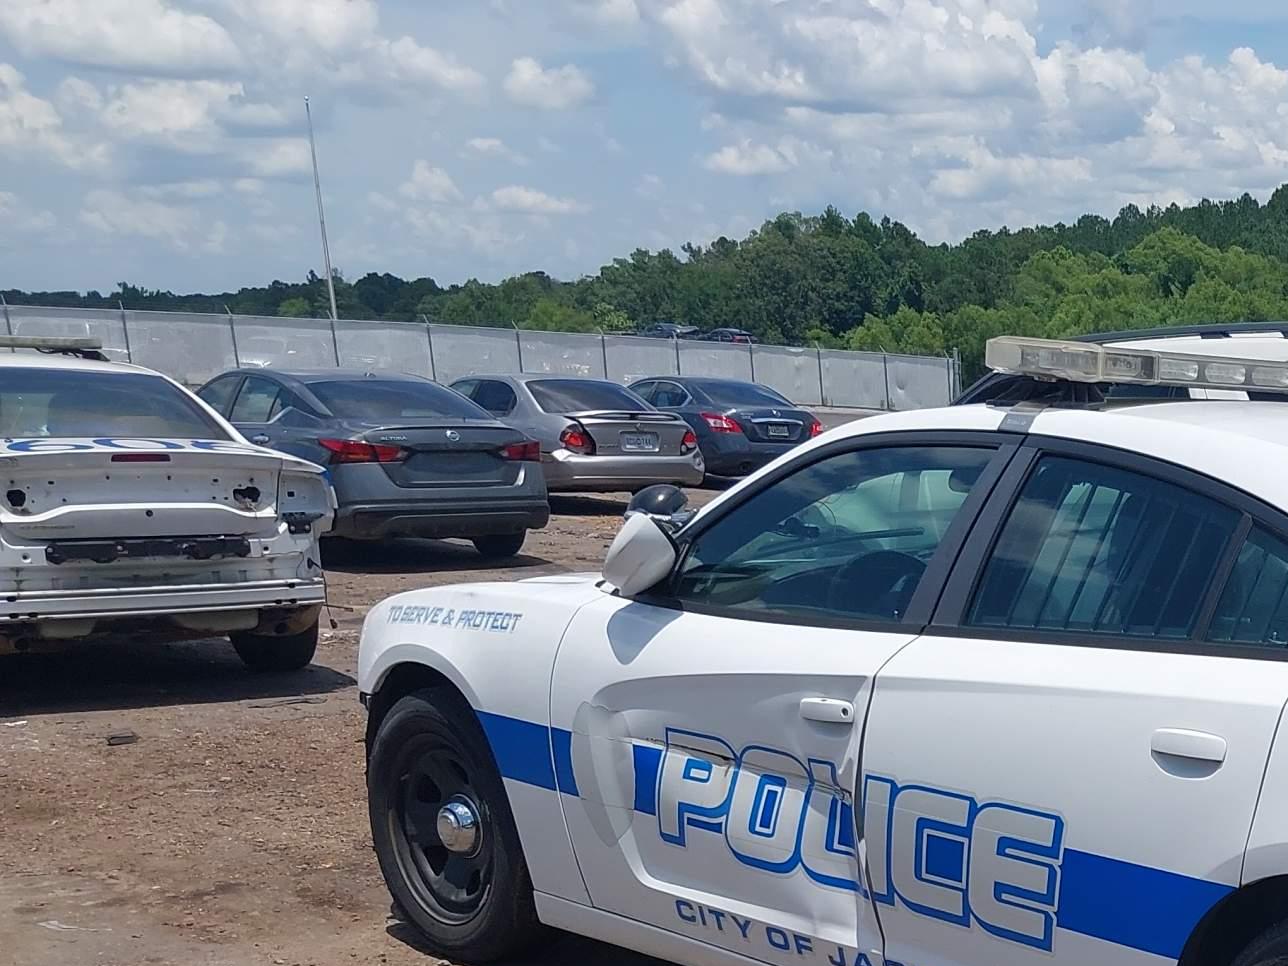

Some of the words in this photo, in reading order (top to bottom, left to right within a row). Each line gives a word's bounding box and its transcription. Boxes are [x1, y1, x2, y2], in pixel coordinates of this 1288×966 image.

[387, 605, 403, 624] TO
[400, 606, 444, 624] SERVE
[441, 609, 456, 625] &
[456, 610, 522, 632] PROTECT
[657, 726, 1064, 953] POLICE
[675, 898, 751, 938] CITY
[766, 925, 813, 955] OF
